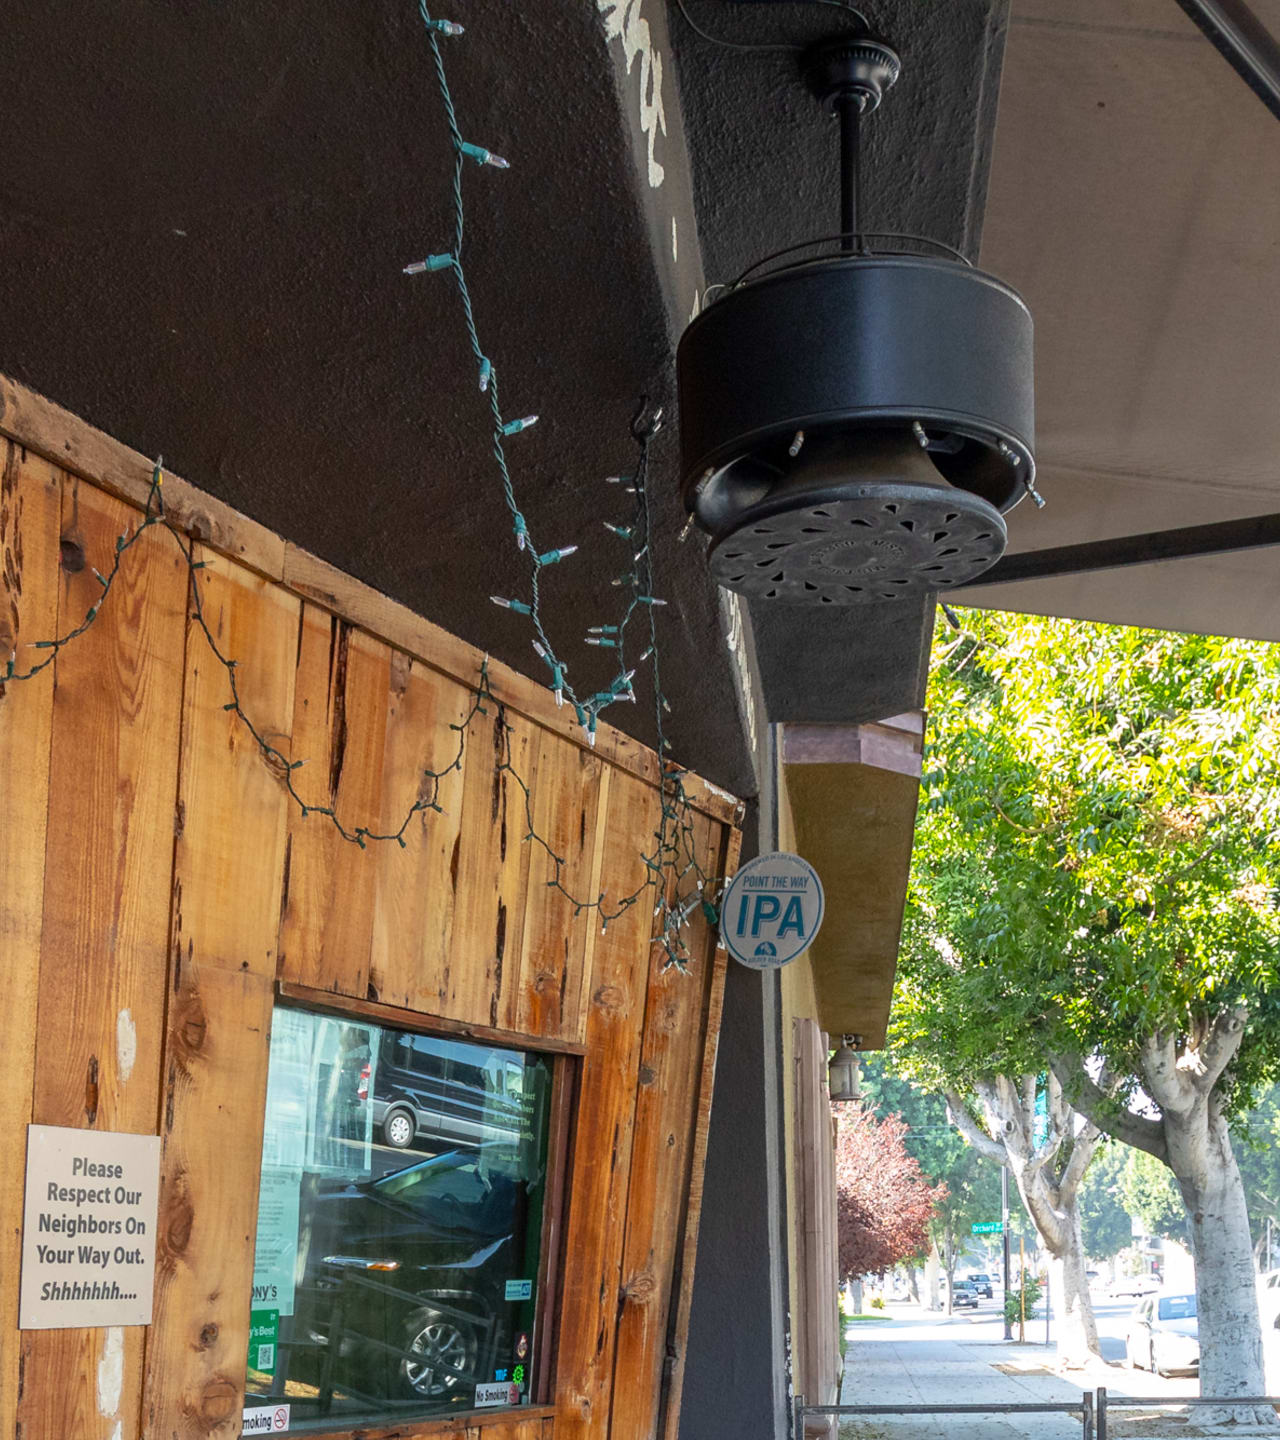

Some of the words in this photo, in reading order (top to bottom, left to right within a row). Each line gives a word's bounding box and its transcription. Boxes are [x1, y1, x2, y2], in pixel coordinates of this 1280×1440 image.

[743, 876, 769, 888] POINT
[771, 876, 788, 888] THE
[790, 876, 809, 888] WAY
[736, 894, 807, 940] IPA
[72, 1157, 123, 1179] Please
[47, 1182, 111, 1207] Respect
[114, 1186, 141, 1205] Our
[38, 1213, 121, 1238] Neighbors
[125, 1217, 146, 1235] On
[36, 1245, 75, 1264] Your
[77, 1246, 110, 1268] Way
[113, 1246, 145, 1264] Out.
[485, 1387, 508, 1403] Smoking
[243, 1414, 272, 1431] moking
